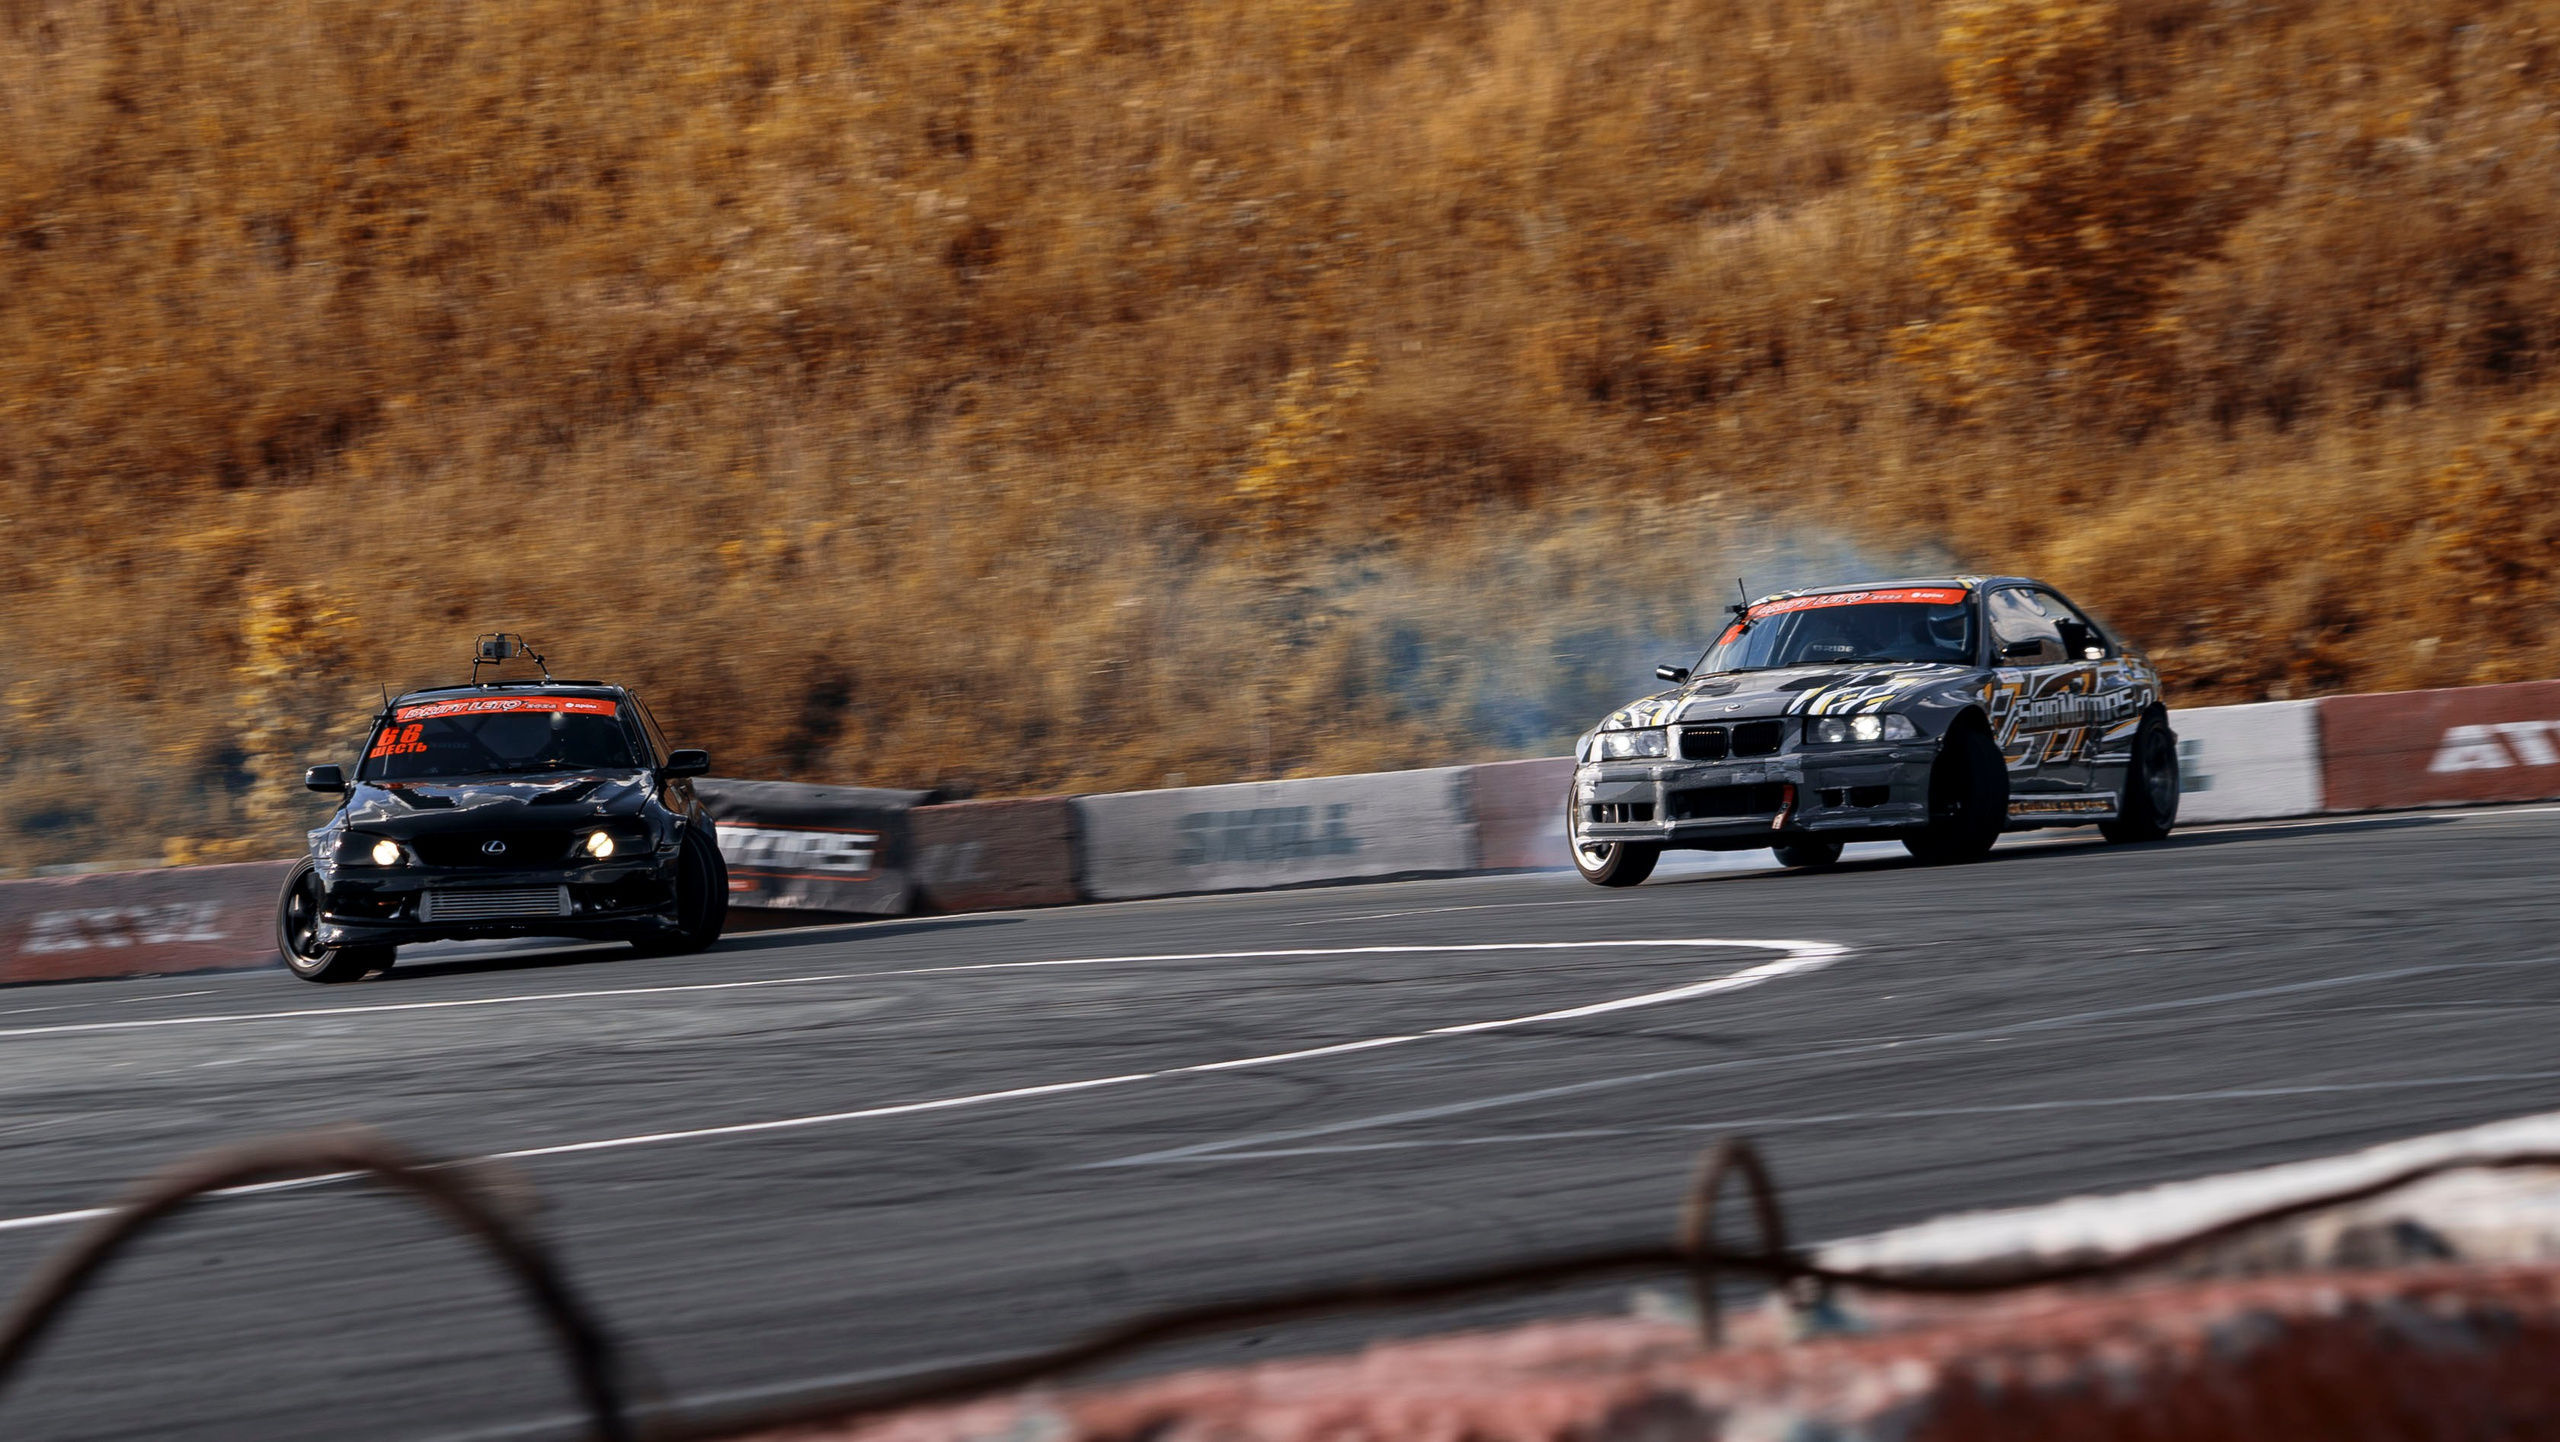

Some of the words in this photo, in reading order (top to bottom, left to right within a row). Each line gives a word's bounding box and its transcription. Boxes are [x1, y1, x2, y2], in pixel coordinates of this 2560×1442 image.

[1813, 644, 1855, 652] BRIDE
[404, 702, 469, 719] DRIFT
[467, 699, 522, 711] LETO
[369, 742, 427, 758] ШЕСТЬ
